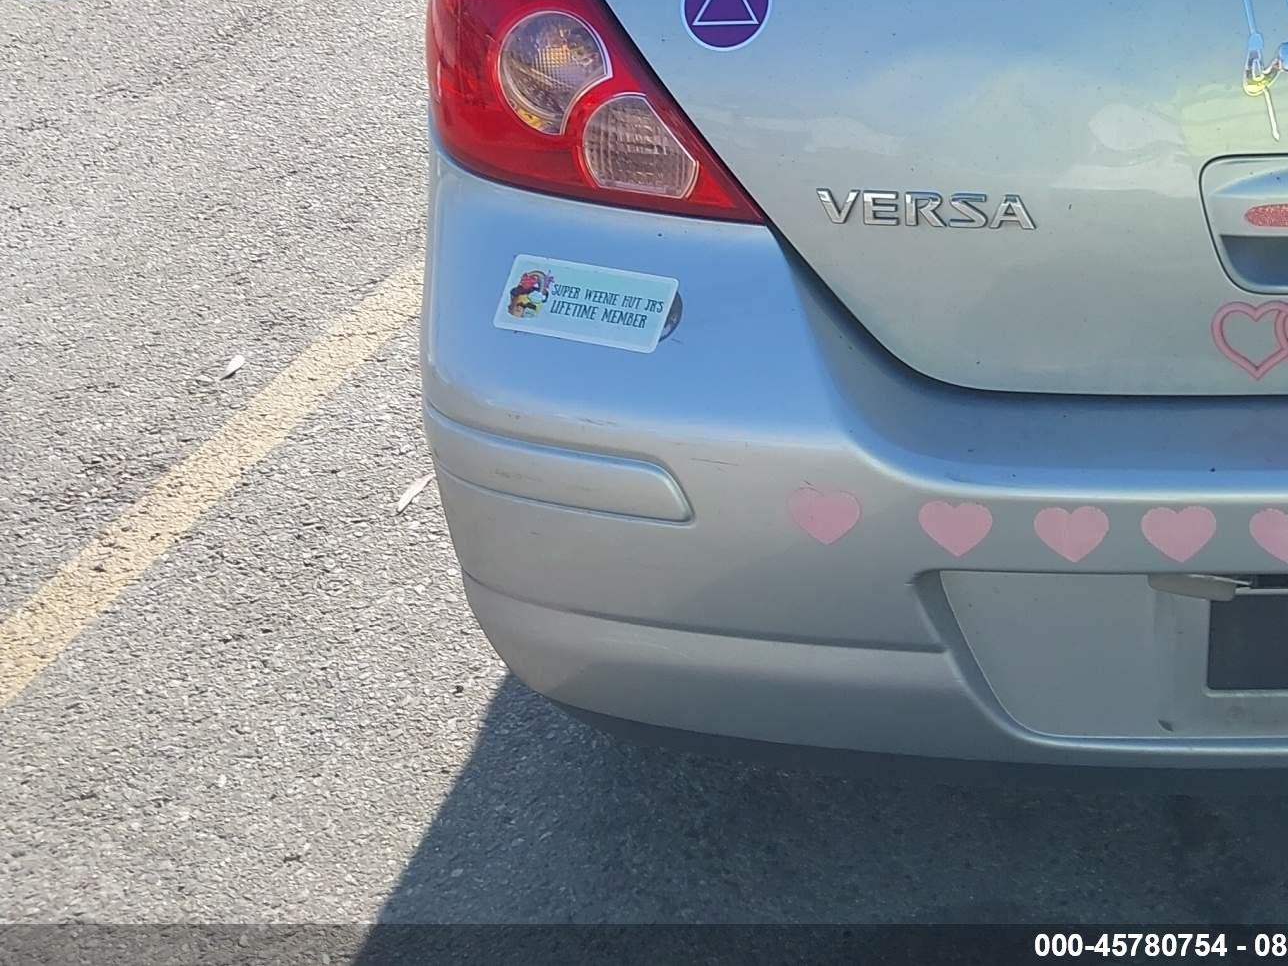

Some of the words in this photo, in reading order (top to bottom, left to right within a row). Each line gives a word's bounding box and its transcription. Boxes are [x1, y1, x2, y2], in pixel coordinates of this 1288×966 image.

[816, 188, 1037, 230] VERSA
[552, 284, 581, 299] SUPER
[584, 289, 619, 306] WEENIE
[621, 295, 642, 309] HUT
[550, 300, 598, 320] LIFETIME
[600, 308, 648, 328] MEMBER
